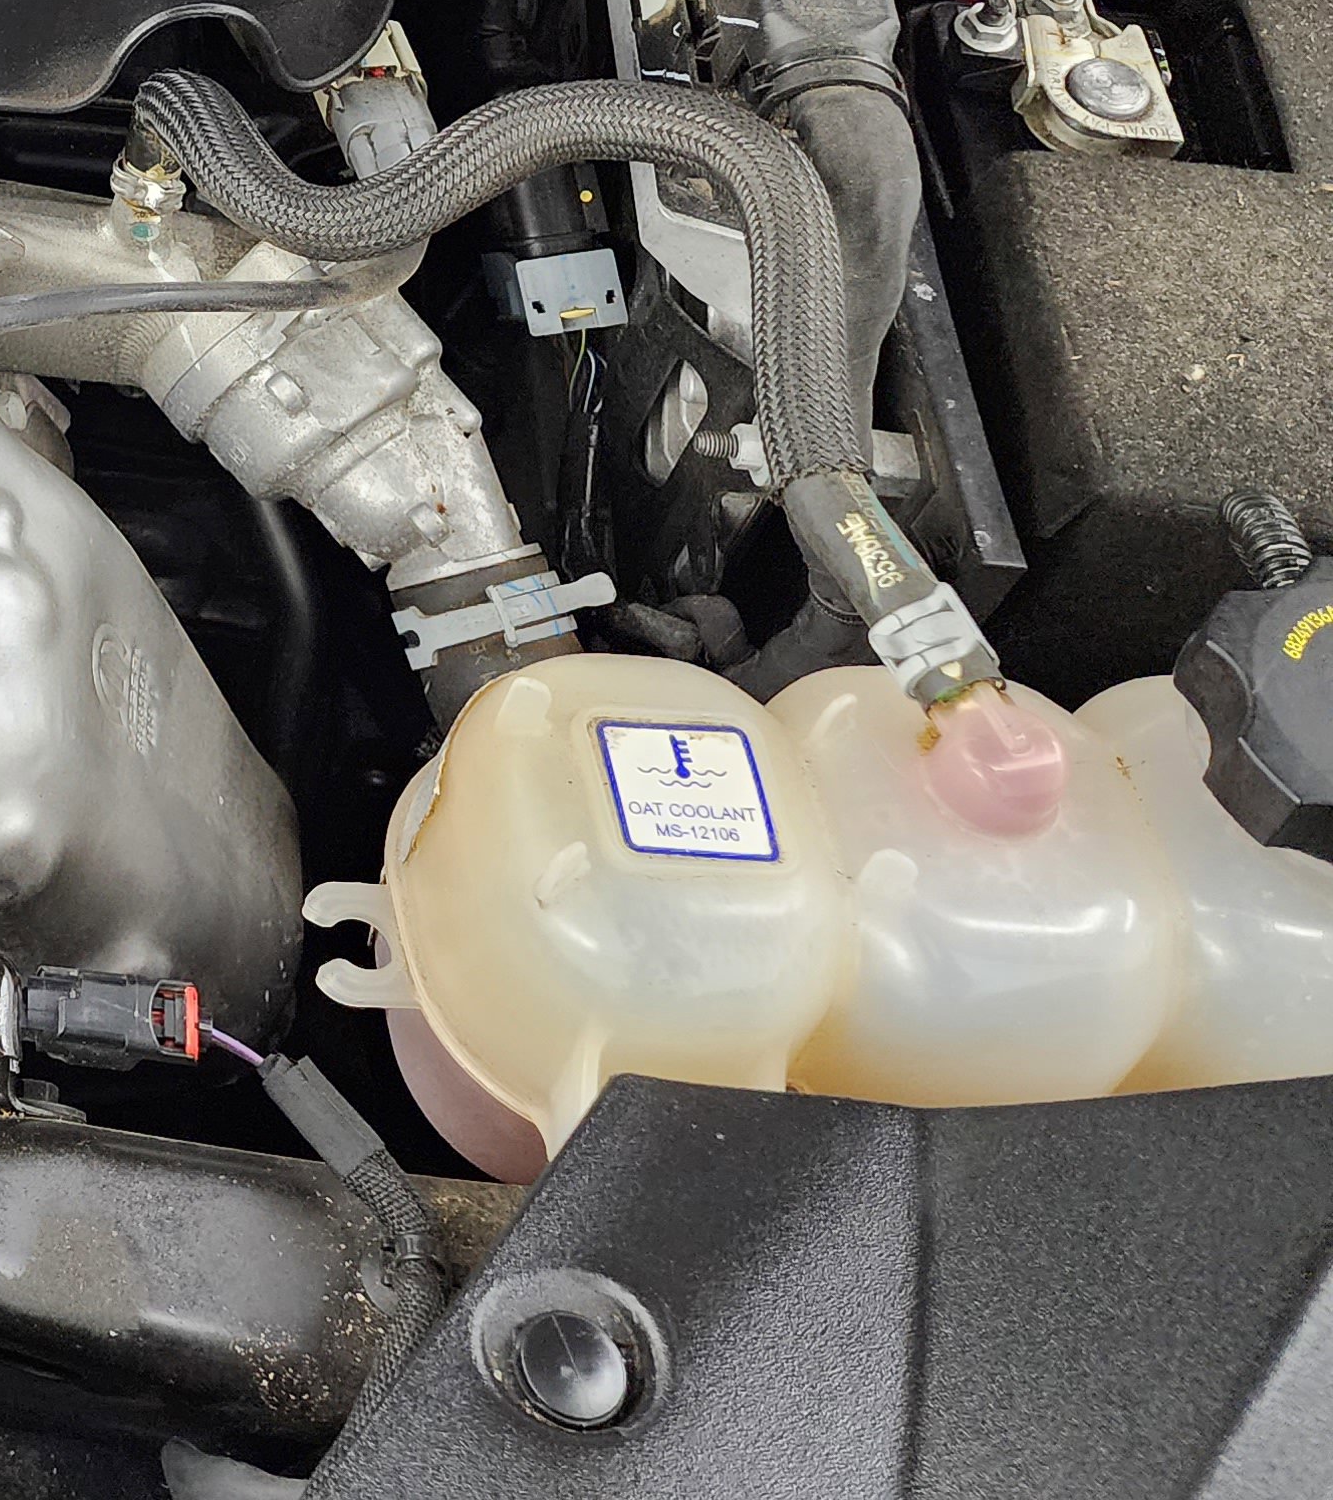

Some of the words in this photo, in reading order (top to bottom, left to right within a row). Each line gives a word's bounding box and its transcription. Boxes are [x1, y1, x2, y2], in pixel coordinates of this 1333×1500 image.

[628, 801, 663, 816] OAT
[669, 803, 757, 823] COOLANT
[656, 823, 740, 842] MS-12106
